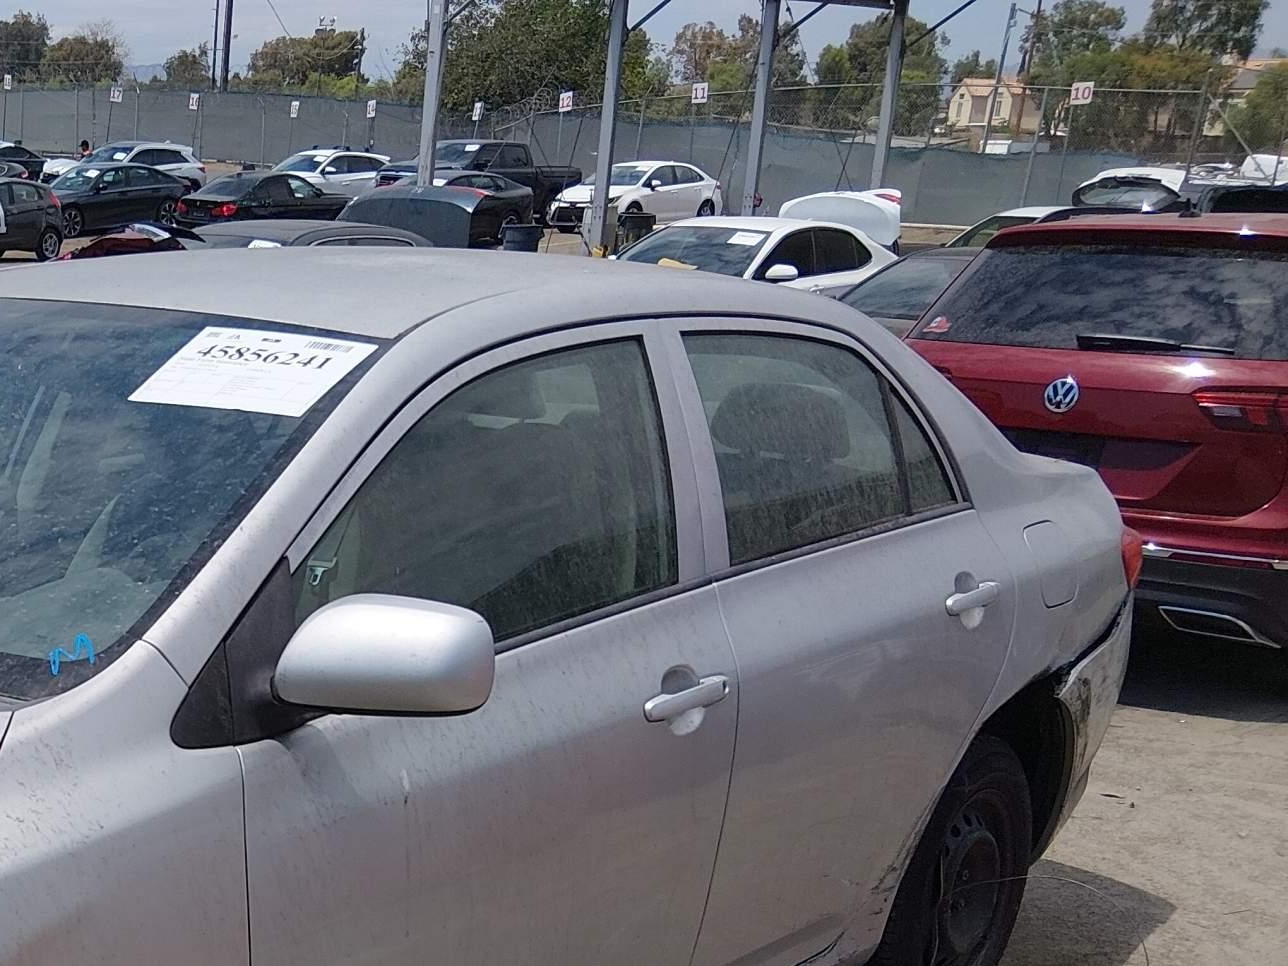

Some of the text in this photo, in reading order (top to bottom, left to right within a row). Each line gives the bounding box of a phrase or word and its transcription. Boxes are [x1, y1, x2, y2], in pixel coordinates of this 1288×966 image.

[112, 89, 122, 99] 17
[693, 87, 706, 100] 11
[1071, 86, 1092, 100] 10
[560, 95, 572, 109] 12
[196, 344, 334, 370] 45856241
